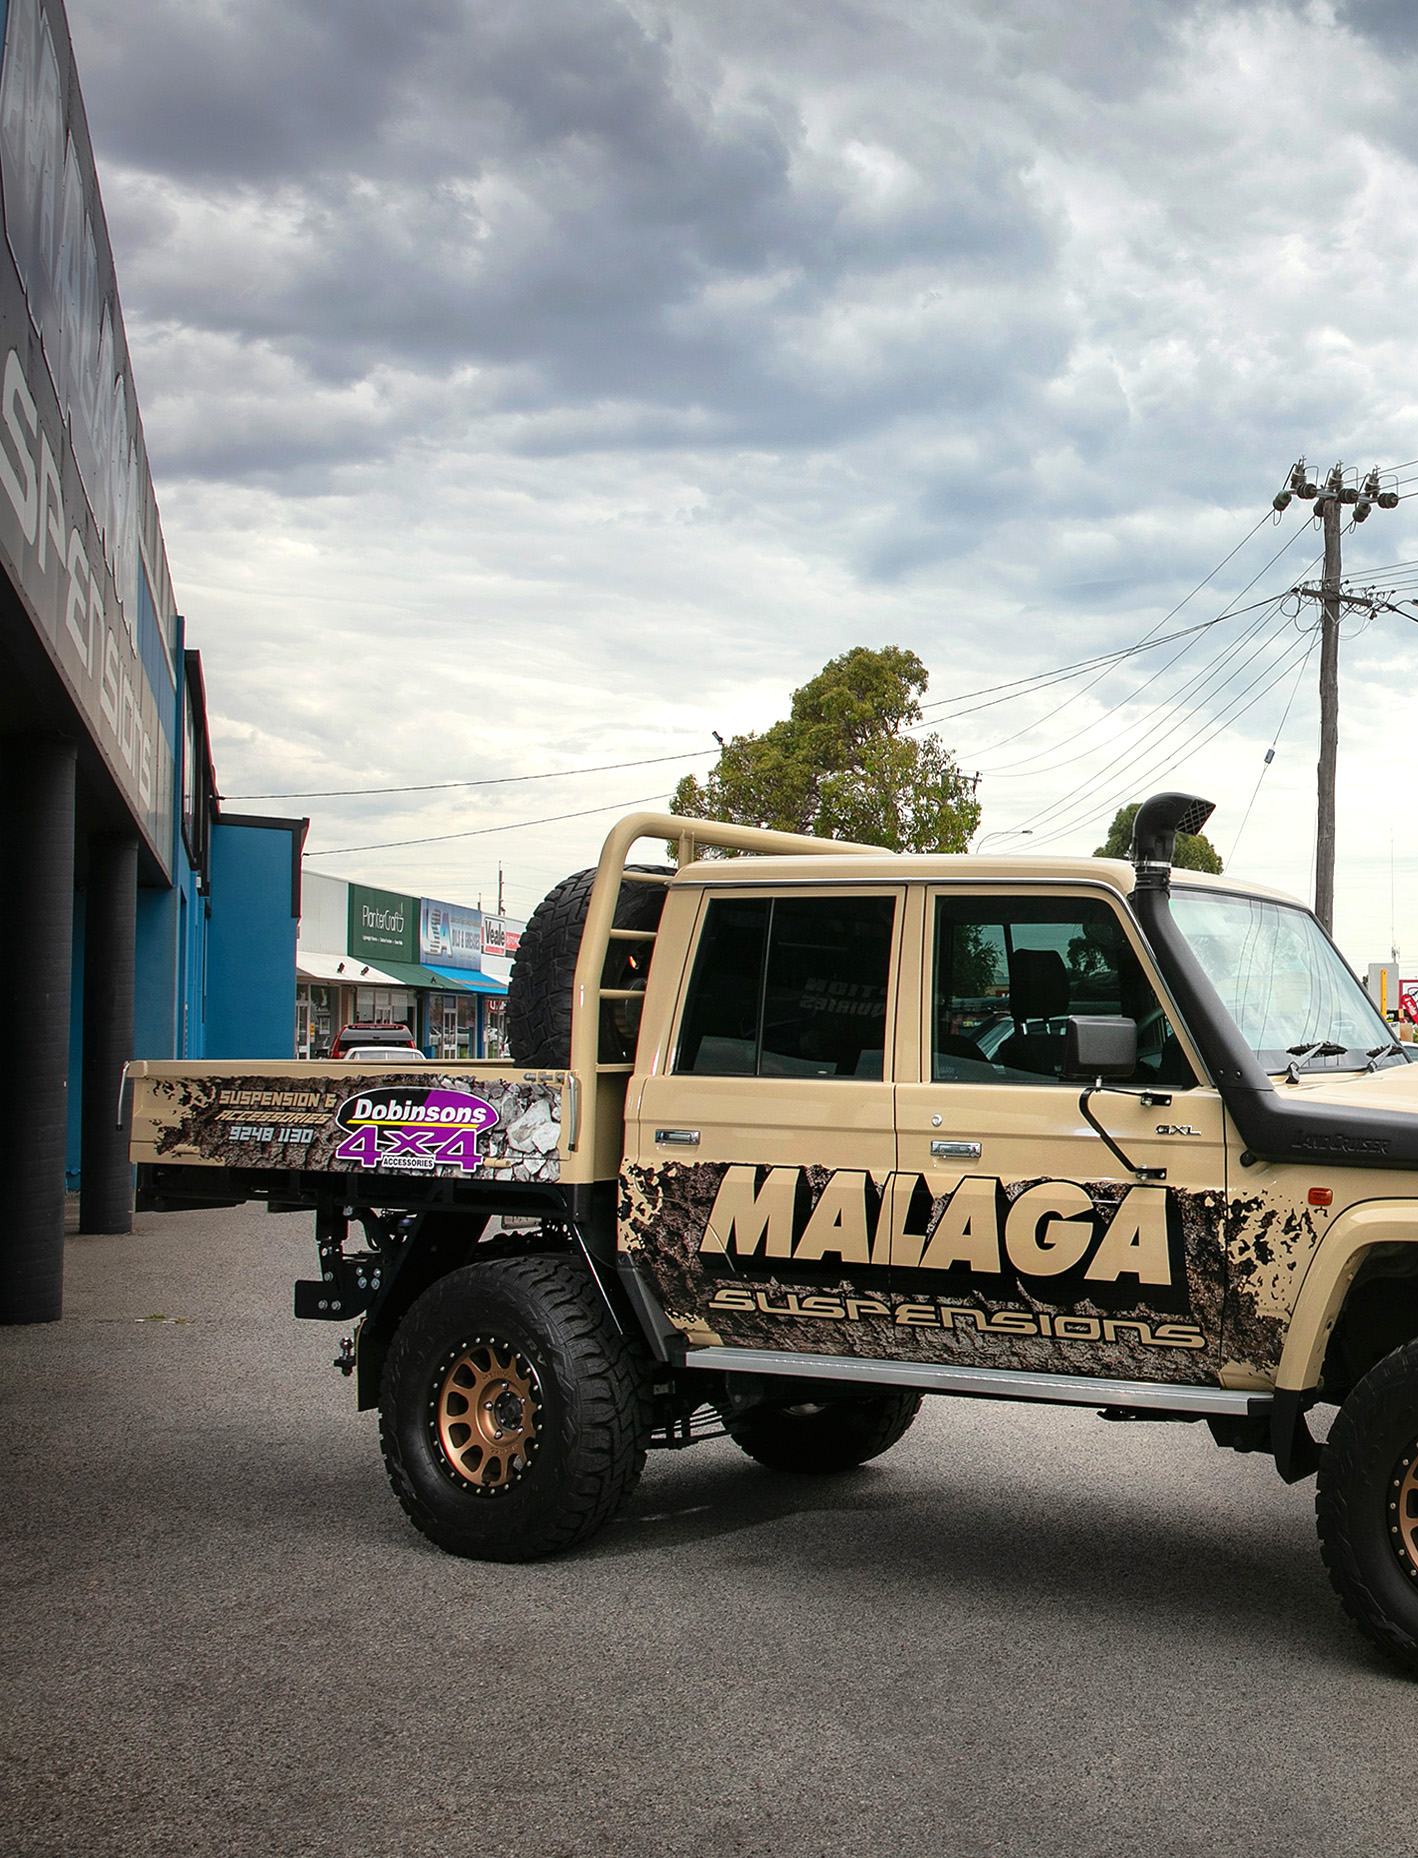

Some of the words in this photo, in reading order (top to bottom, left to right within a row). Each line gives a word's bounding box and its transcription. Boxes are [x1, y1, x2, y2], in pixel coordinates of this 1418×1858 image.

[485, 919, 505, 947] Veale
[219, 1090, 320, 1107] SUSPENSION
[214, 1110, 333, 1124] ACCESSORIES
[352, 1099, 487, 1124] Dobinsons
[228, 1126, 274, 1141] 9248
[278, 1128, 314, 1143] 1130
[1155, 1124, 1202, 1136] GXL
[383, 1158, 433, 1167] ACCESSORIES
[699, 1165, 1172, 1286] MALAGA
